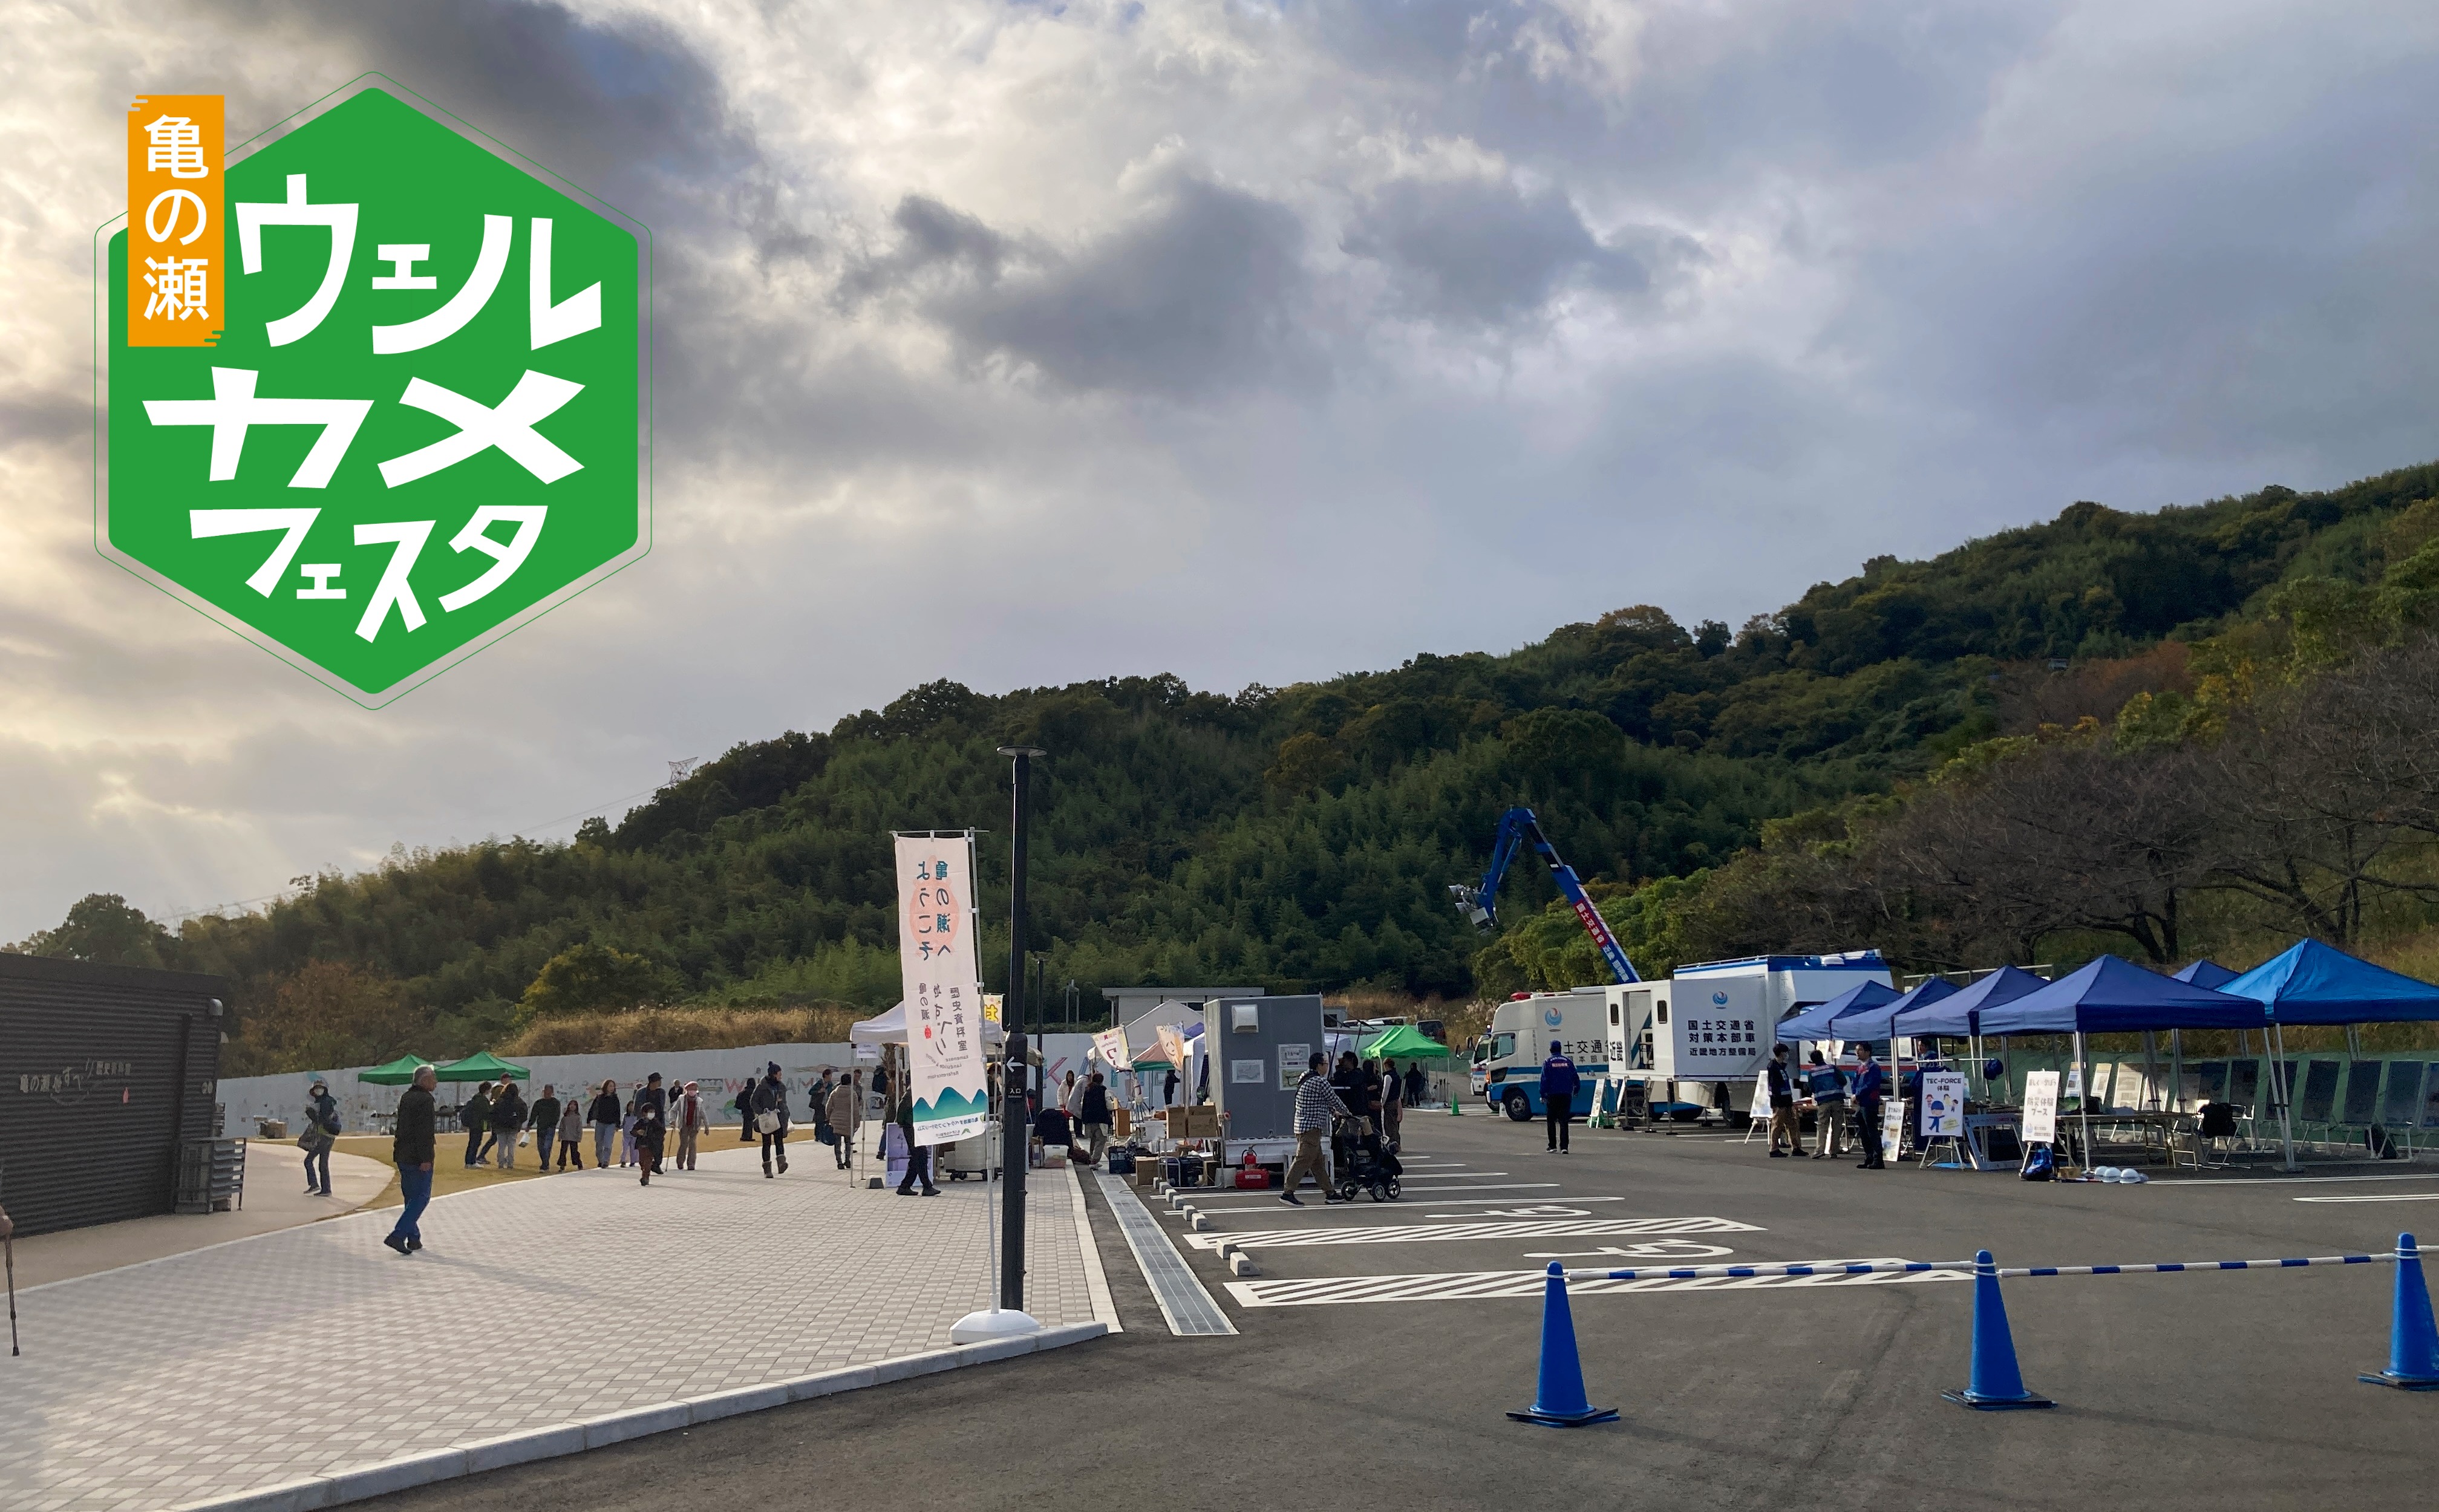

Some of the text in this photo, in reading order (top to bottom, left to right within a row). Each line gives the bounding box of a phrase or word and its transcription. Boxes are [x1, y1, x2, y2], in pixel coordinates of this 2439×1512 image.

[1688, 1020, 1754, 1030] 国土交通省
[1689, 1032, 1755, 1043] 対策本部車
[1564, 1040, 1608, 1054] 土交通
